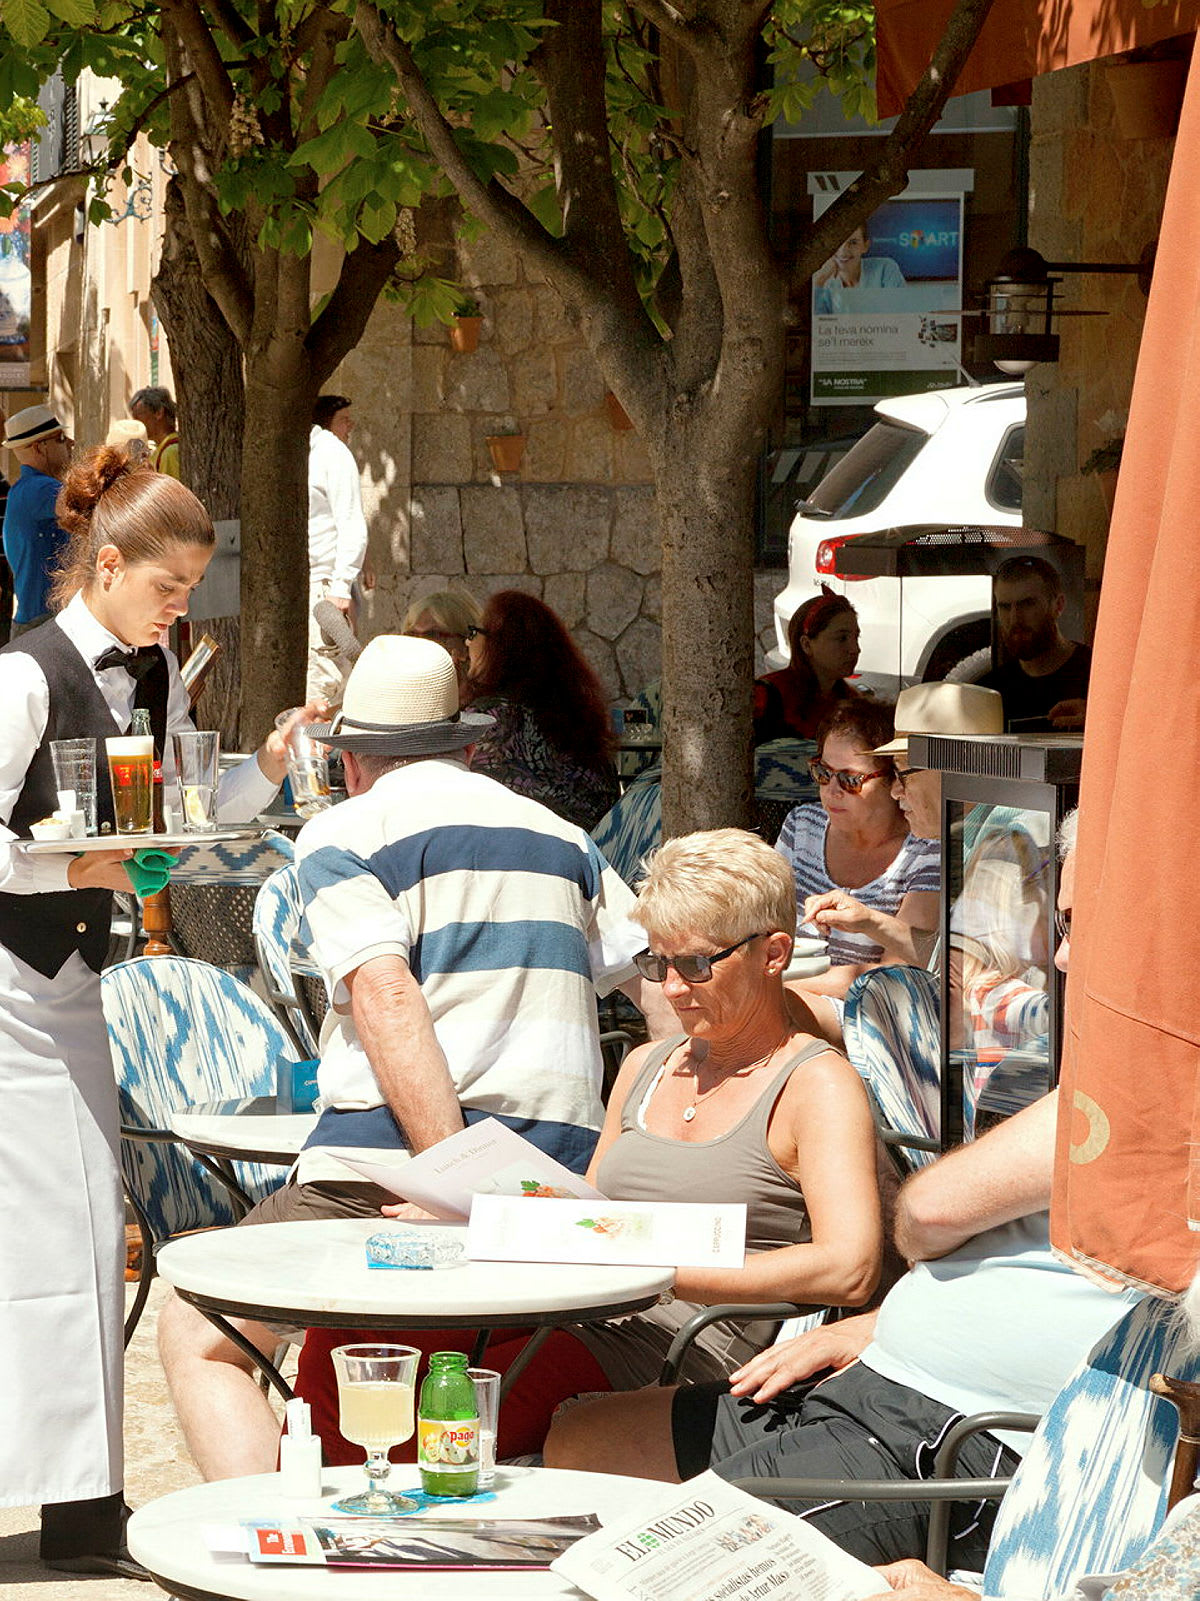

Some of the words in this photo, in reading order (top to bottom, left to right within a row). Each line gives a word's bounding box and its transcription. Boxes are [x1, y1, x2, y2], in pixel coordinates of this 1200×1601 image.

[818, 325, 831, 335] La
[833, 325, 857, 335] teva
[449, 1431, 475, 1444] pago
[615, 1543, 650, 1562] EL
[653, 1500, 716, 1543] MUNDO
[747, 1580, 772, 1601] Artur
